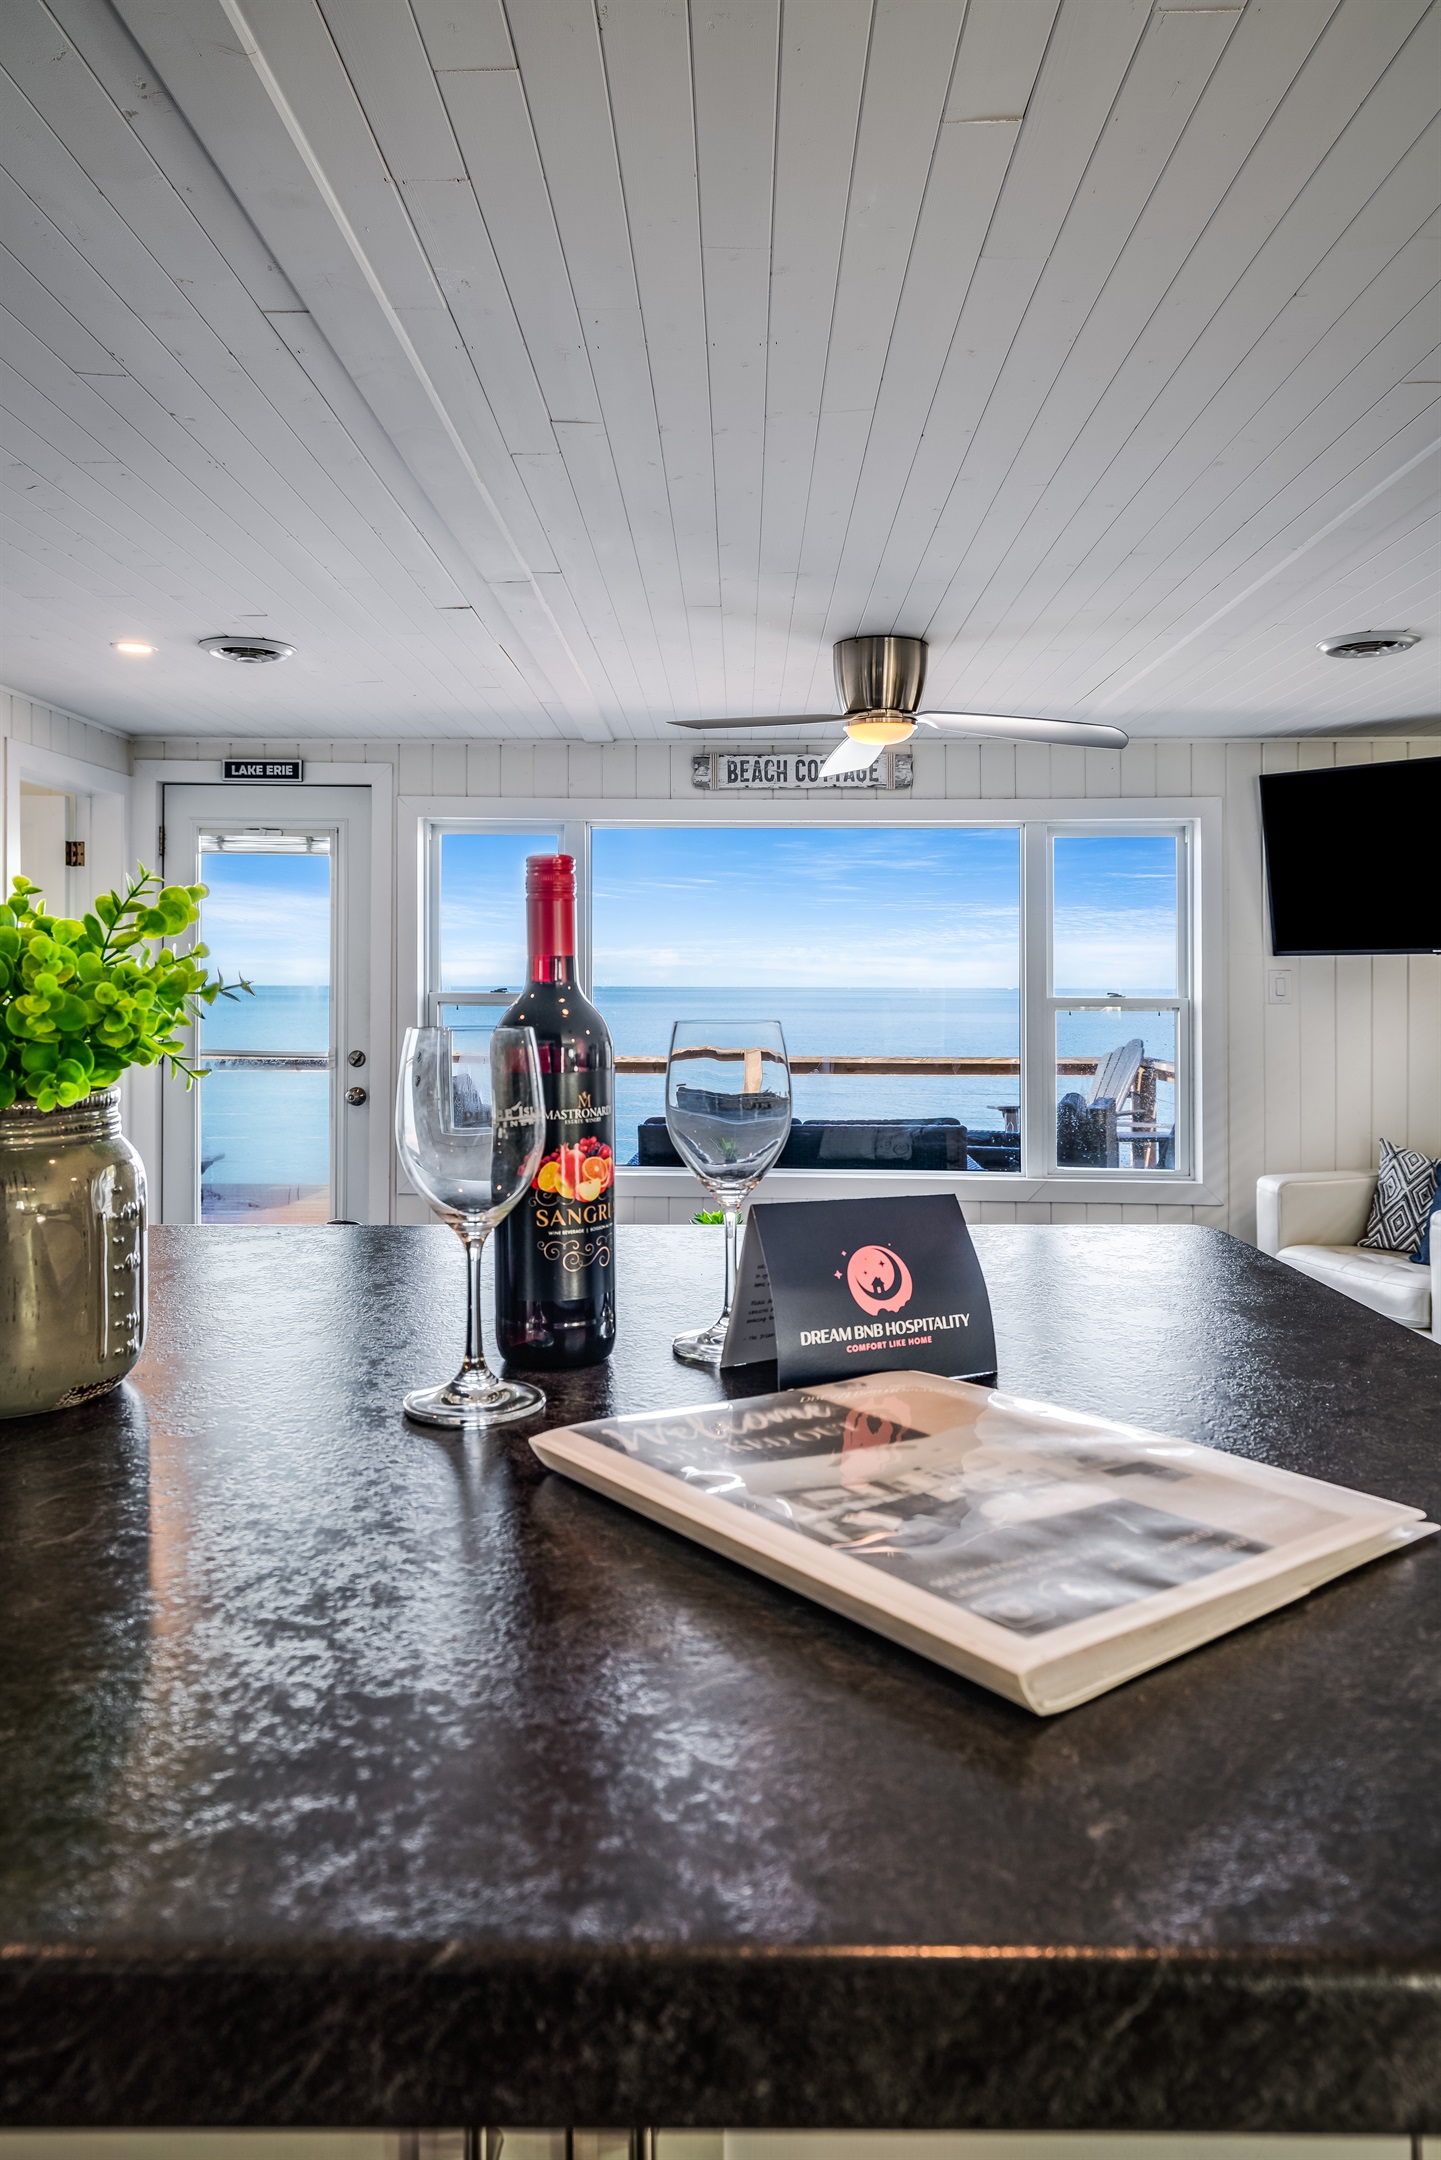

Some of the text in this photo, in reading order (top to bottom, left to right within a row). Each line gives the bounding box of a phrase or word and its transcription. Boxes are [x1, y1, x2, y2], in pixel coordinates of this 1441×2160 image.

[231, 764, 294, 776] LAKE ERIE
[727, 759, 788, 784] BEACH
[535, 1202, 612, 1228] SANGRI
[800, 1313, 970, 1347] DREAM BNB HOSPITALITY
[846, 1335, 933, 1354] COMFORT LIKE HOME
